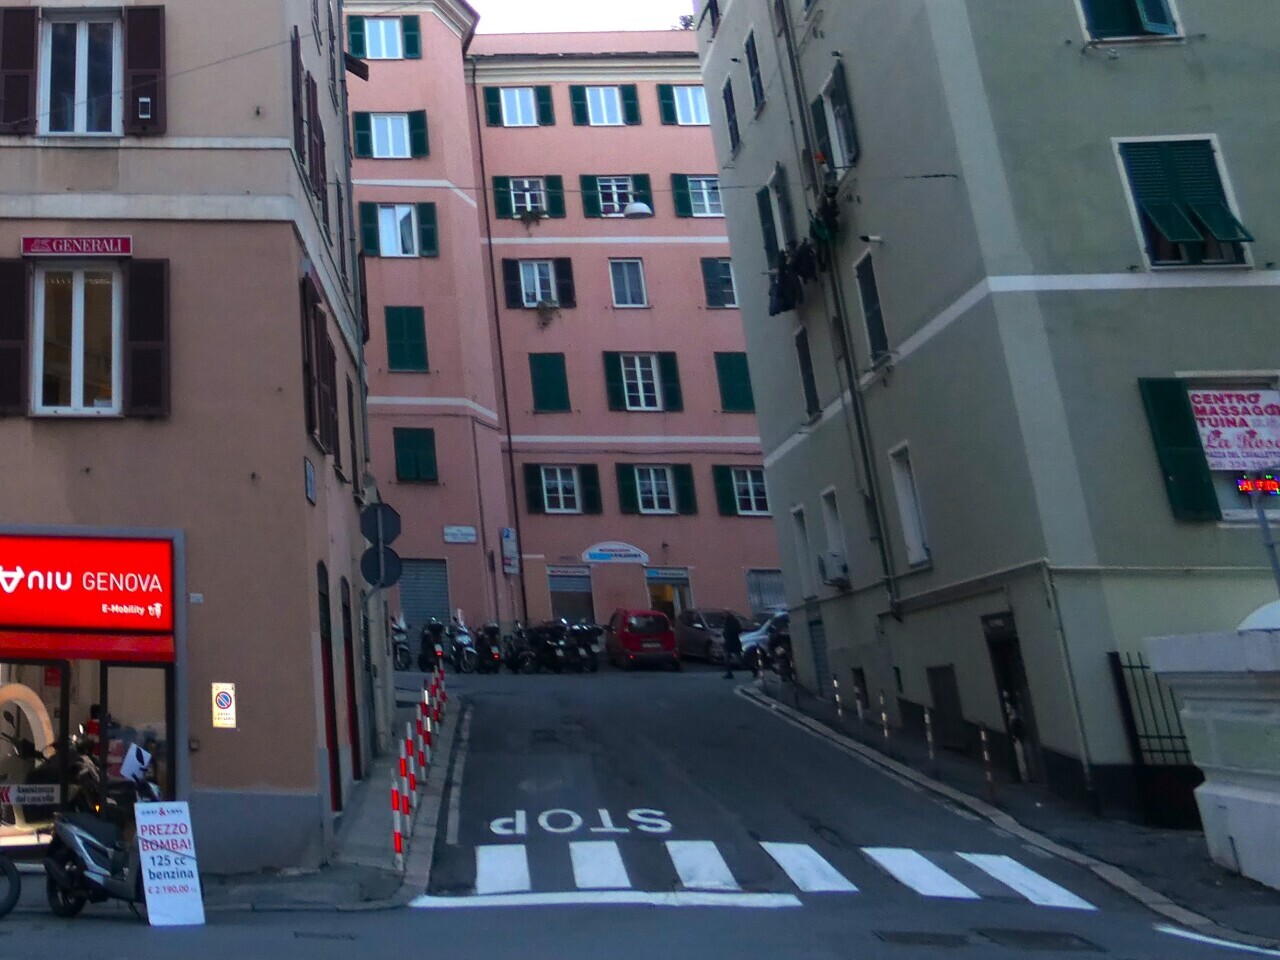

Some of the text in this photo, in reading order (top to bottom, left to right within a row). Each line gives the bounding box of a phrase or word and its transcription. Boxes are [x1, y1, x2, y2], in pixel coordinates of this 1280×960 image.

[52, 239, 122, 252] GENERALI
[1191, 393, 1261, 404] CENTRO
[1196, 417, 1249, 428] TUINA
[27, 570, 163, 593] niu GENOVA
[101, 603, 145, 617] E-Mobility
[489, 807, 673, 836] STOP
[140, 822, 189, 836] PREZZO
[141, 838, 193, 853] BOMBA!
[150, 855, 187, 867] 125 cc
[147, 868, 195, 881] benzina
